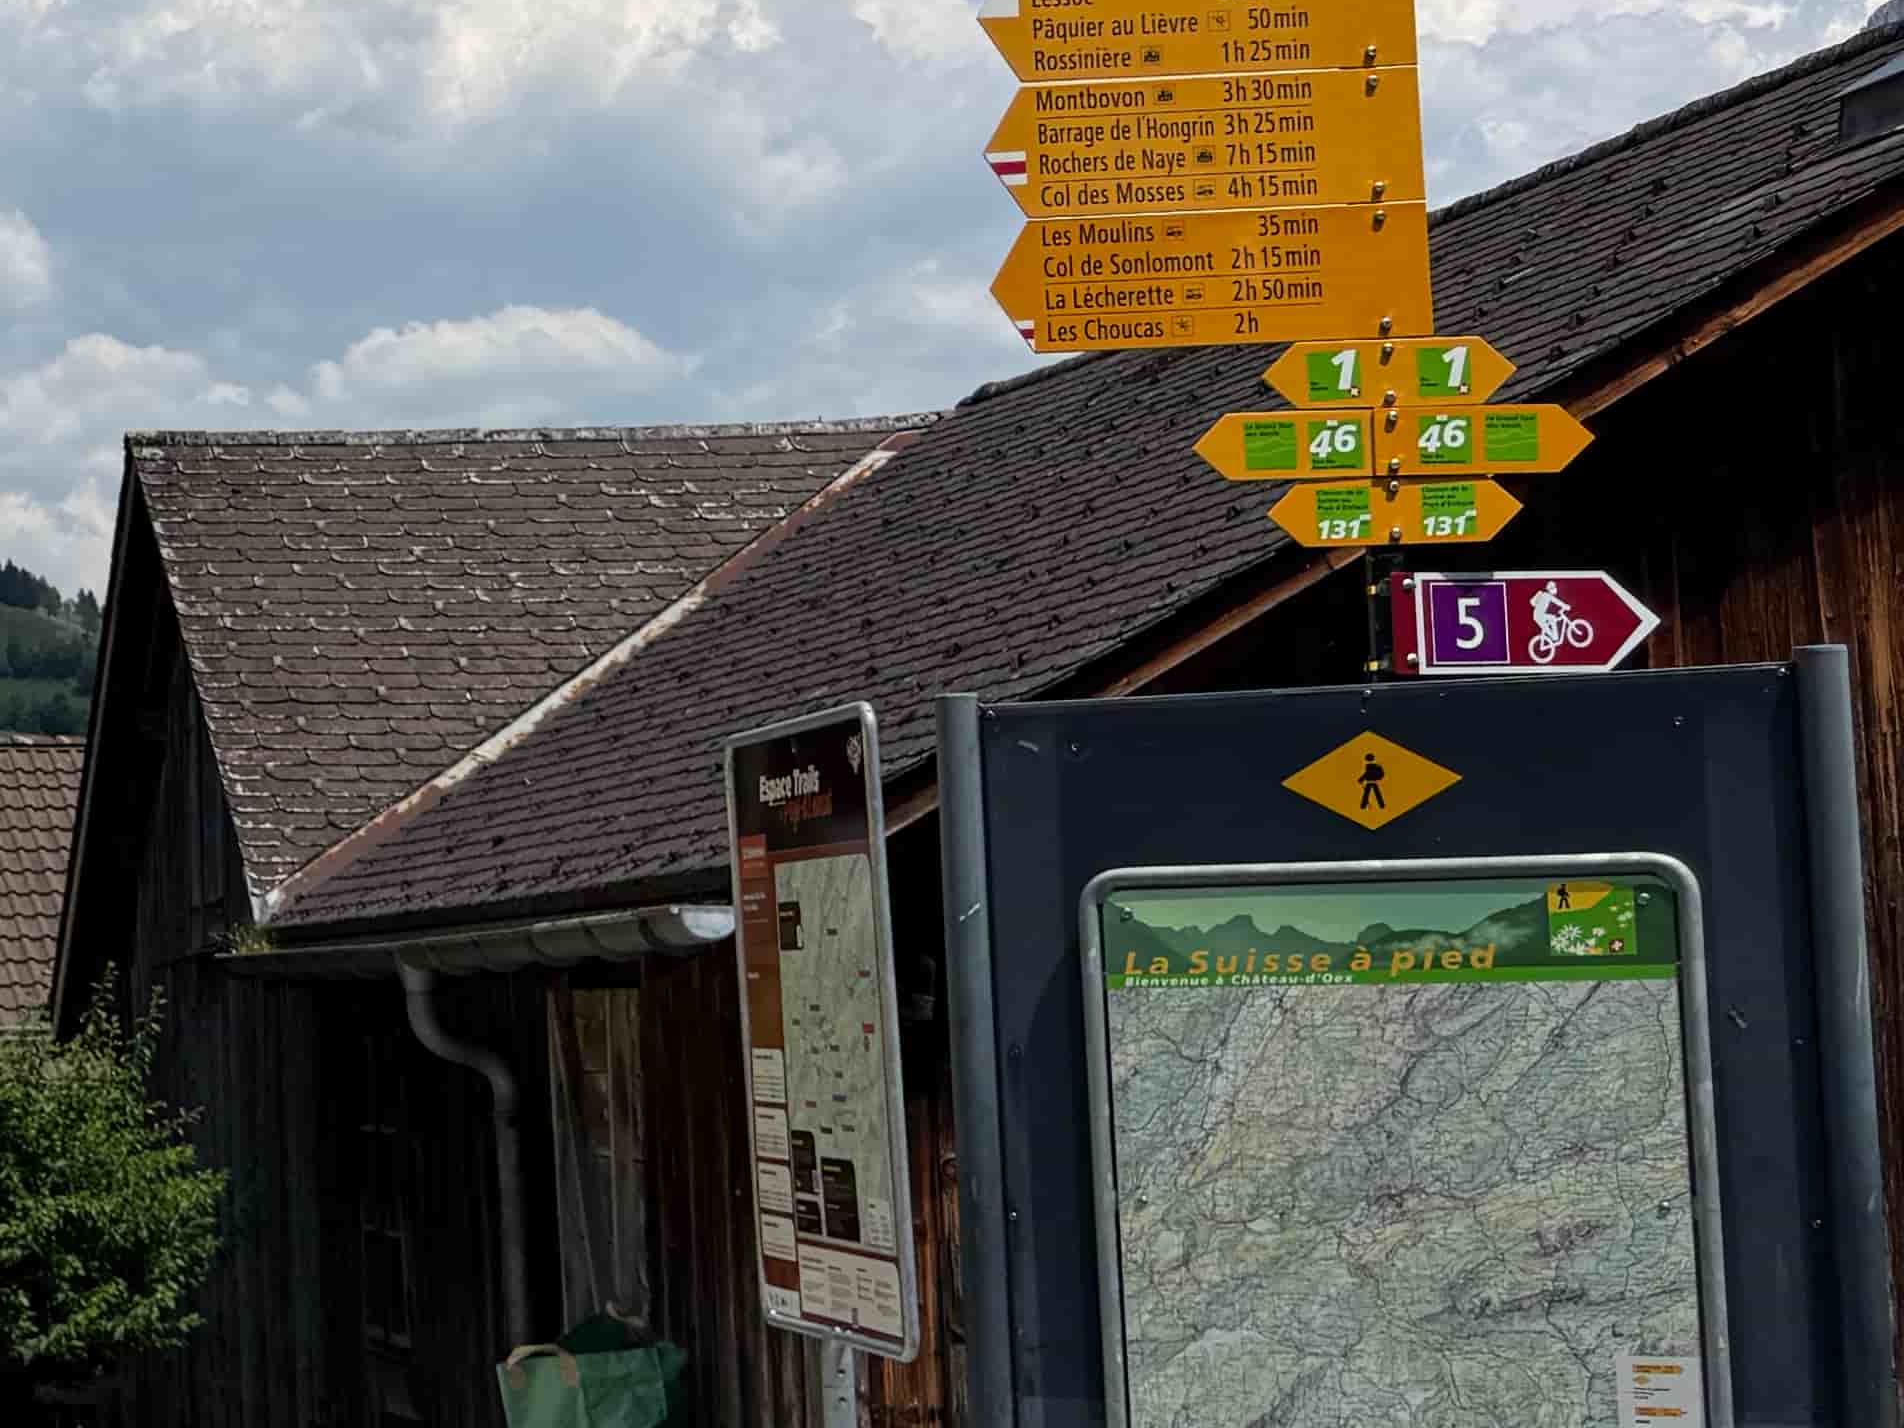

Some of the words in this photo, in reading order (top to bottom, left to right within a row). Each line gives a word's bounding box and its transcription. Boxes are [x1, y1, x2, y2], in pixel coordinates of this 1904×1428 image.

[1033, 17, 1104, 44] Pâquier
[1112, 20, 1133, 36] au
[1141, 13, 1198, 34] Lièvre
[1035, 48, 1131, 71] Rossinière
[1036, 86, 1144, 111] Montbovon
[1038, 124, 1104, 148] Barrage
[1111, 119, 1130, 140] de
[1040, 151, 1108, 174] Rochers
[1115, 149, 1135, 171] de
[1142, 148, 1186, 175] Naye
[1041, 184, 1070, 207] Col
[1078, 183, 1109, 205] des
[1116, 183, 1184, 204] Mosses
[1042, 226, 1071, 246] Les
[1080, 220, 1154, 244] Moulins
[1044, 255, 1073, 277] Col
[1081, 254, 1102, 276] de
[1110, 252, 1214, 275] Sonlomont
[1045, 290, 1065, 310] La
[1073, 285, 1173, 308] Lécherette
[1048, 322, 1077, 342] Les
[1084, 318, 1163, 340] Choucas
[1331, 349, 1357, 390] 1
[1442, 346, 1468, 387] 1
[1310, 425, 1357, 457] 46
[1418, 419, 1467, 452] 46
[1319, 520, 1360, 540] 131
[1424, 516, 1465, 536] 131
[1455, 596, 1483, 651] 5
[1124, 950, 1170, 975] La
[1188, 948, 1333, 975] Suisse
[1349, 945, 1372, 972] à
[1390, 943, 1496, 976] pied
[1125, 975, 1210, 987] Bienvenue
